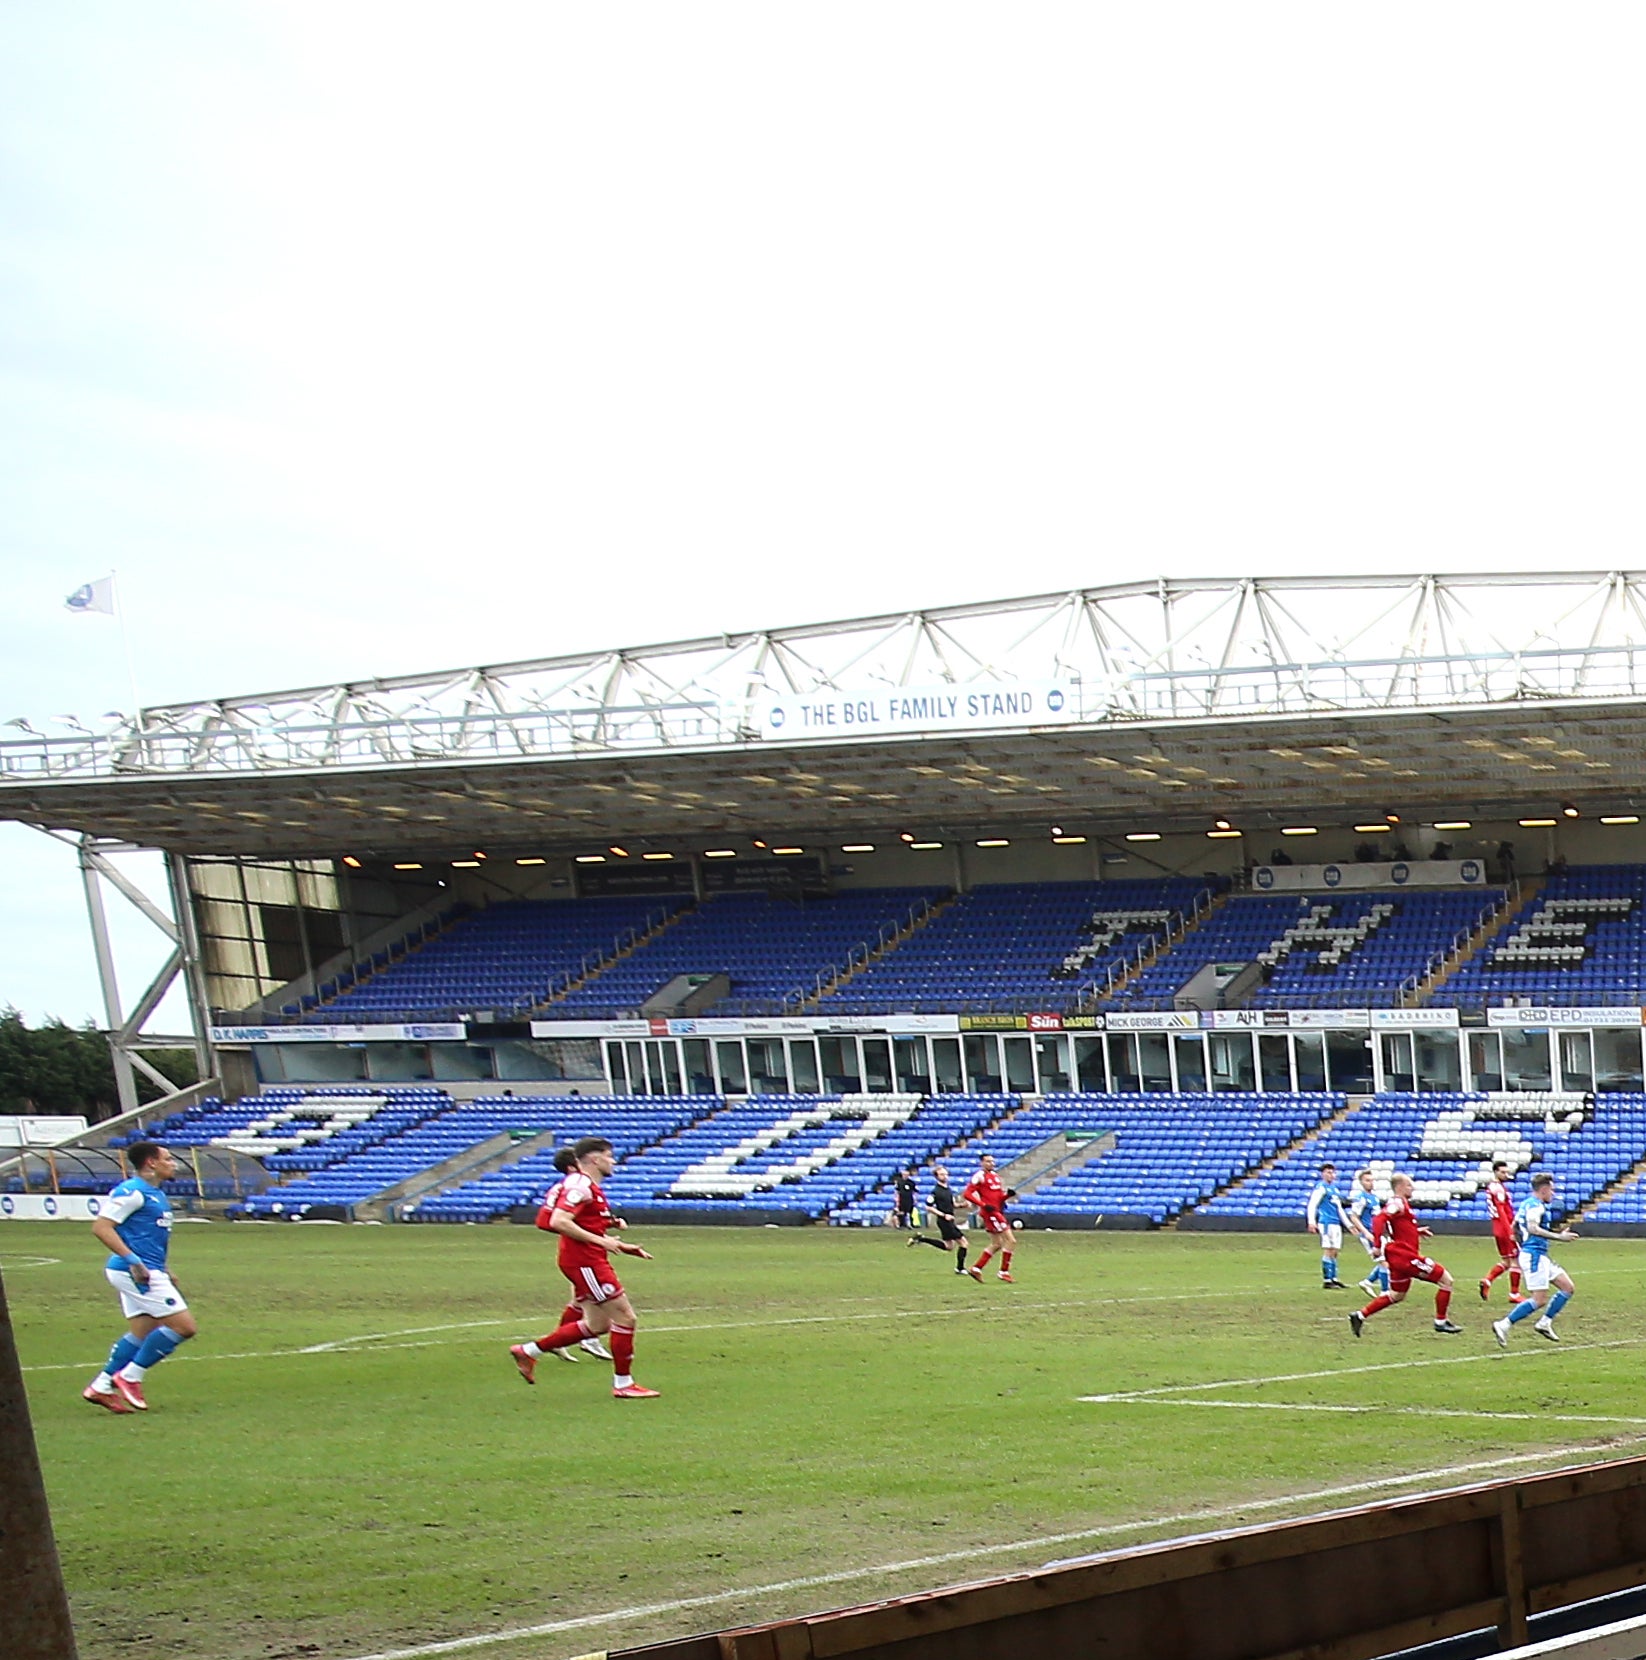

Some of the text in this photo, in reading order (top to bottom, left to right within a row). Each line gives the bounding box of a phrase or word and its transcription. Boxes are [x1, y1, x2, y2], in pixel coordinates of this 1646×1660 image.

[800, 692, 1032, 727] THE BGL FAMILY STAND
[1108, 1016, 1163, 1027] MICK GEORGE
[1550, 1009, 1582, 1022] EPD
